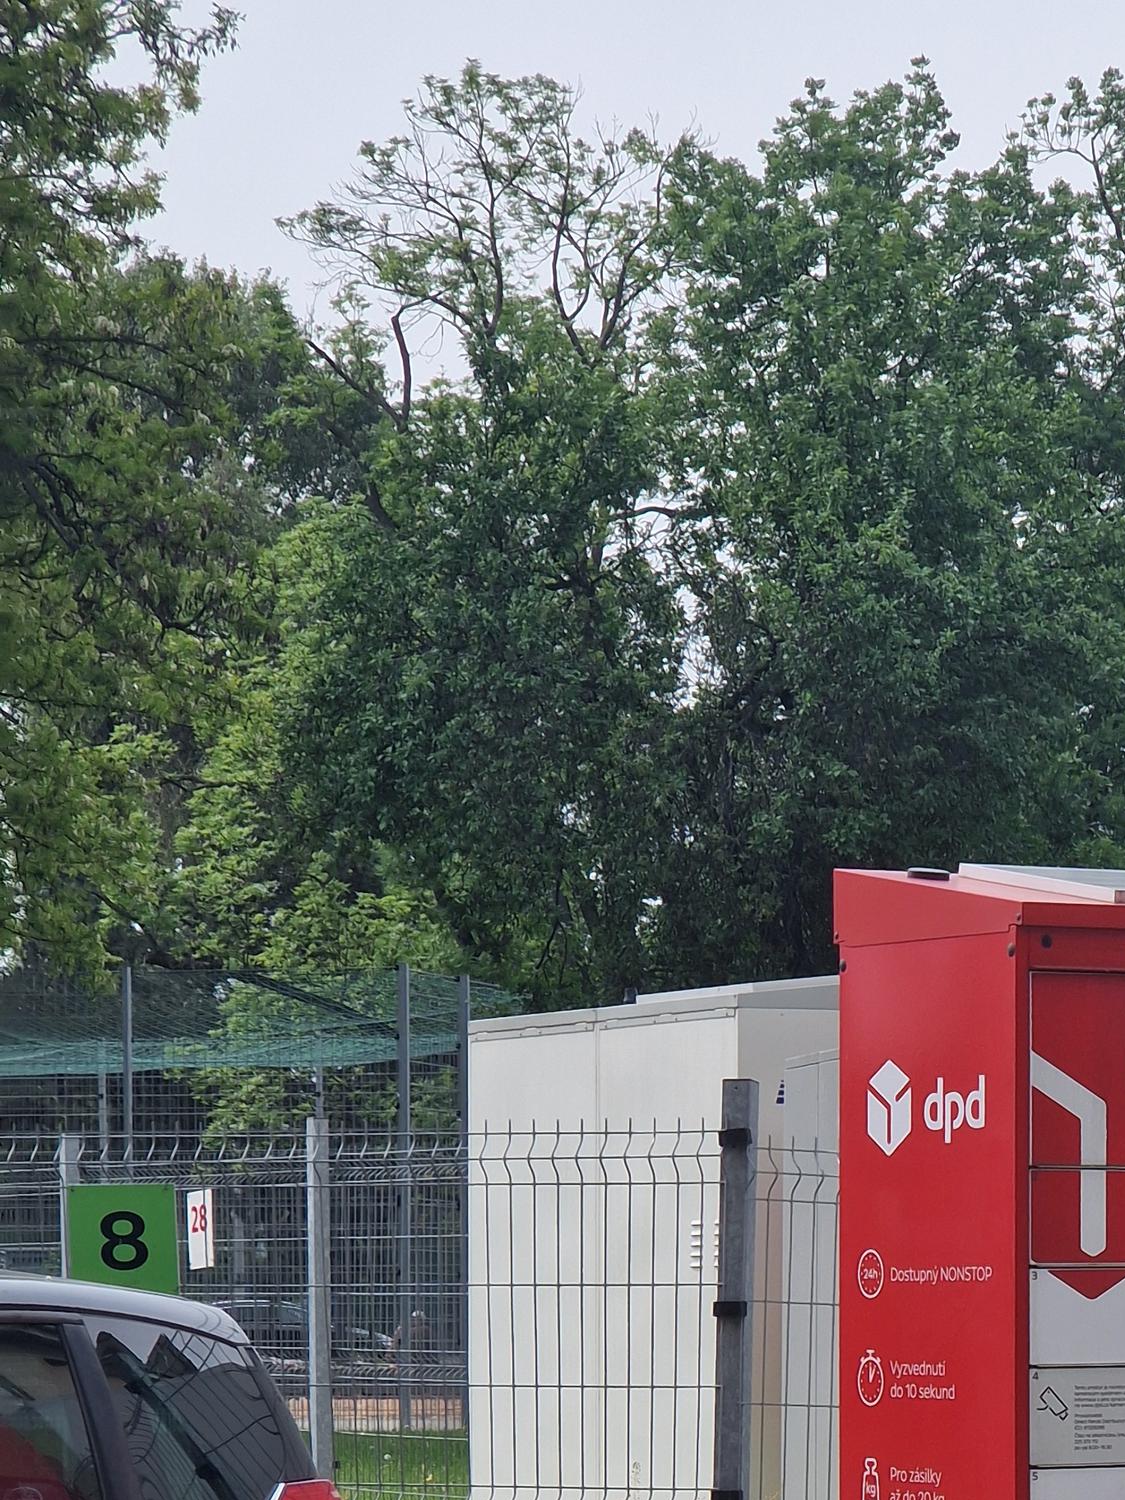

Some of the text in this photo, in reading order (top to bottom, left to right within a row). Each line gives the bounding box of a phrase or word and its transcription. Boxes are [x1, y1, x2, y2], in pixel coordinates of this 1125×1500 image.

[924, 1074, 986, 1144] dpd
[191, 1204, 207, 1233] 28
[100, 1211, 148, 1270] 8
[863, 1268, 878, 1279] 24h
[890, 1265, 992, 1285] Dostupný NONSTOP
[1031, 1270, 1038, 1280] 3
[889, 1360, 946, 1379] Vyzvednutí
[1032, 1371, 1039, 1380] 4
[890, 1382, 956, 1400] do 10 sekund
[889, 1467, 942, 1487] Pro zásilky
[1032, 1471, 1038, 1481] 5
[866, 1482, 876, 1497] kg
